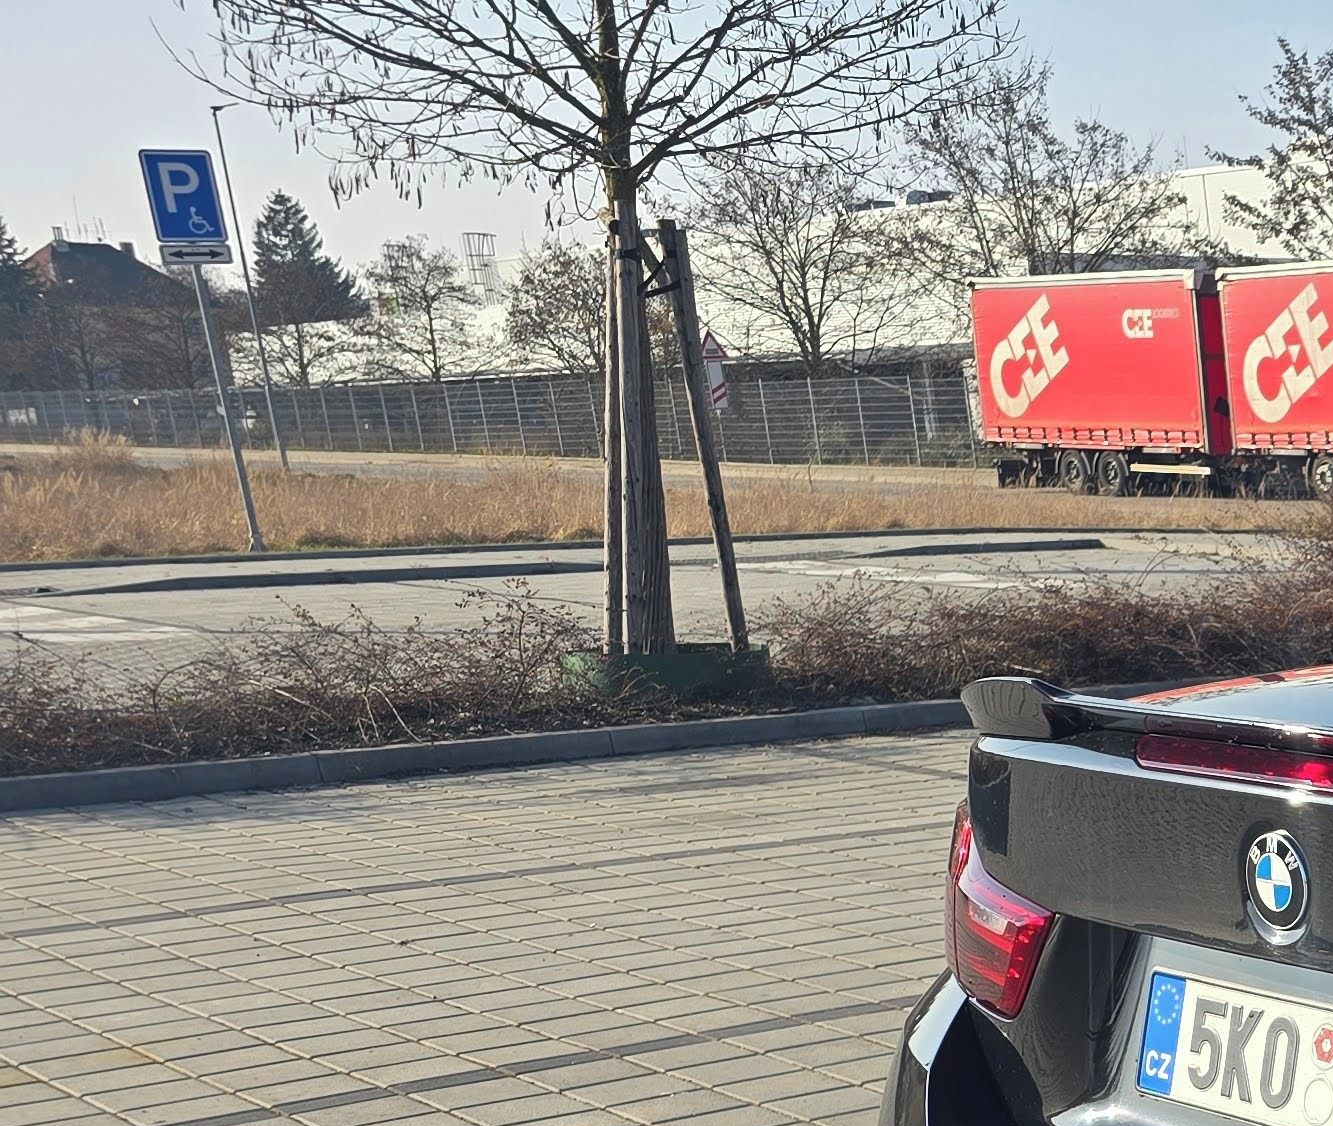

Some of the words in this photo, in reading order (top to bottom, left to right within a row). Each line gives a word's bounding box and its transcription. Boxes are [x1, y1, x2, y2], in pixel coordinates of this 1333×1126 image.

[157, 162, 199, 213] P
[1122, 308, 1154, 339] CEE
[990, 293, 1069, 418] CEE
[1249, 836, 1299, 871] BMW
[1145, 1049, 1170, 1080] CZ
[1187, 996, 1300, 1110] 5K0
